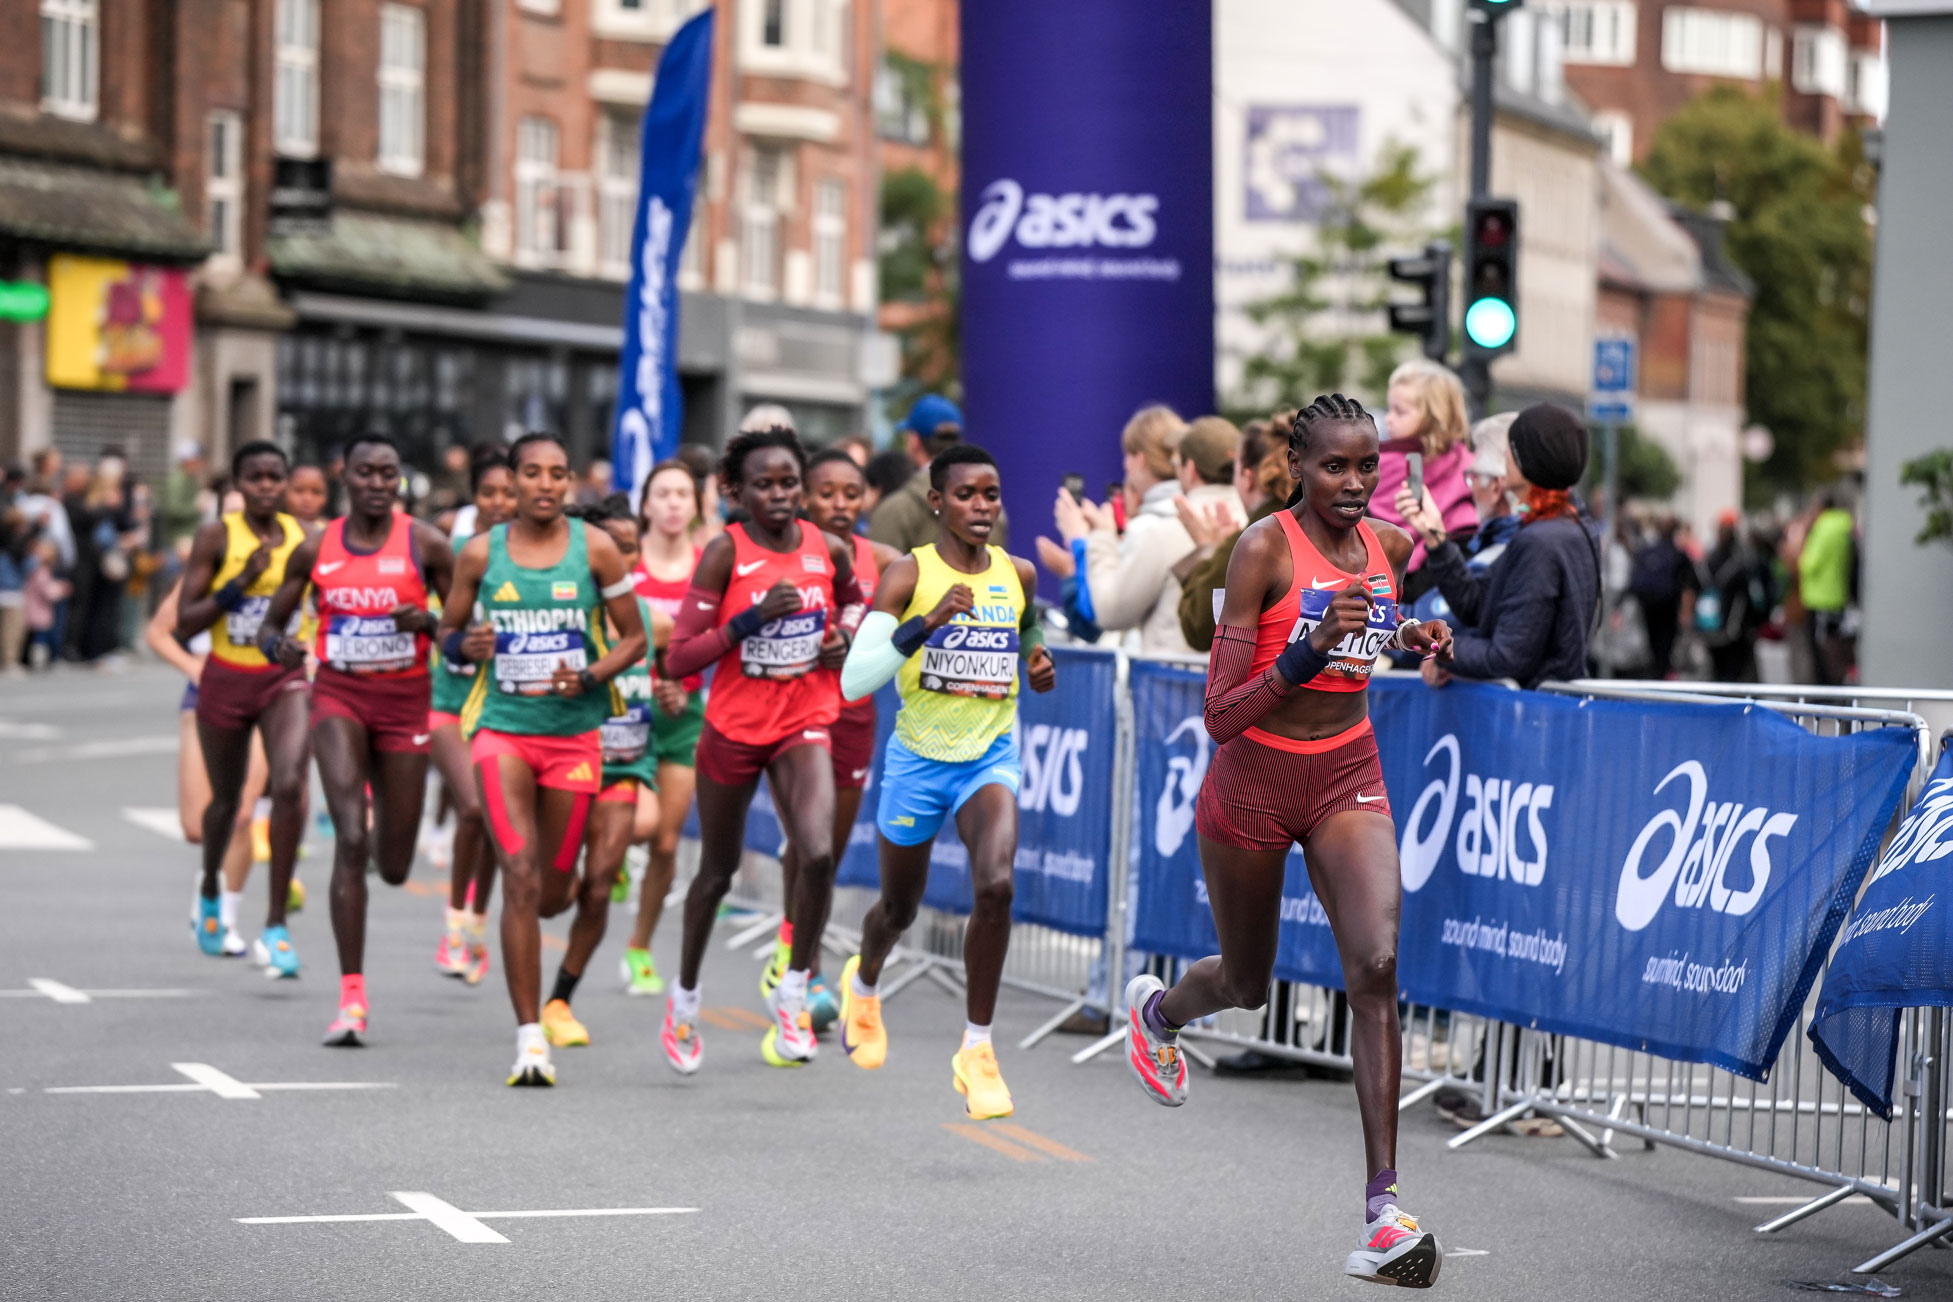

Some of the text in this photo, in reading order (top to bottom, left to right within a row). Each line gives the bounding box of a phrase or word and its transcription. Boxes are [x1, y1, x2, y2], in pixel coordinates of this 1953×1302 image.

[326, 586, 399, 611] KENYA
[751, 586, 826, 608] KYA
[489, 607, 587, 633] ETHIOPIA
[951, 604, 1017, 623] ANDA
[333, 636, 410, 656] JERONO
[965, 629, 1009, 649] asics
[1298, 622, 1391, 656] NTICH
[945, 682, 1009, 694] COPENHAGEN
[1456, 773, 1555, 887] asics
[1674, 801, 1799, 916] asics
